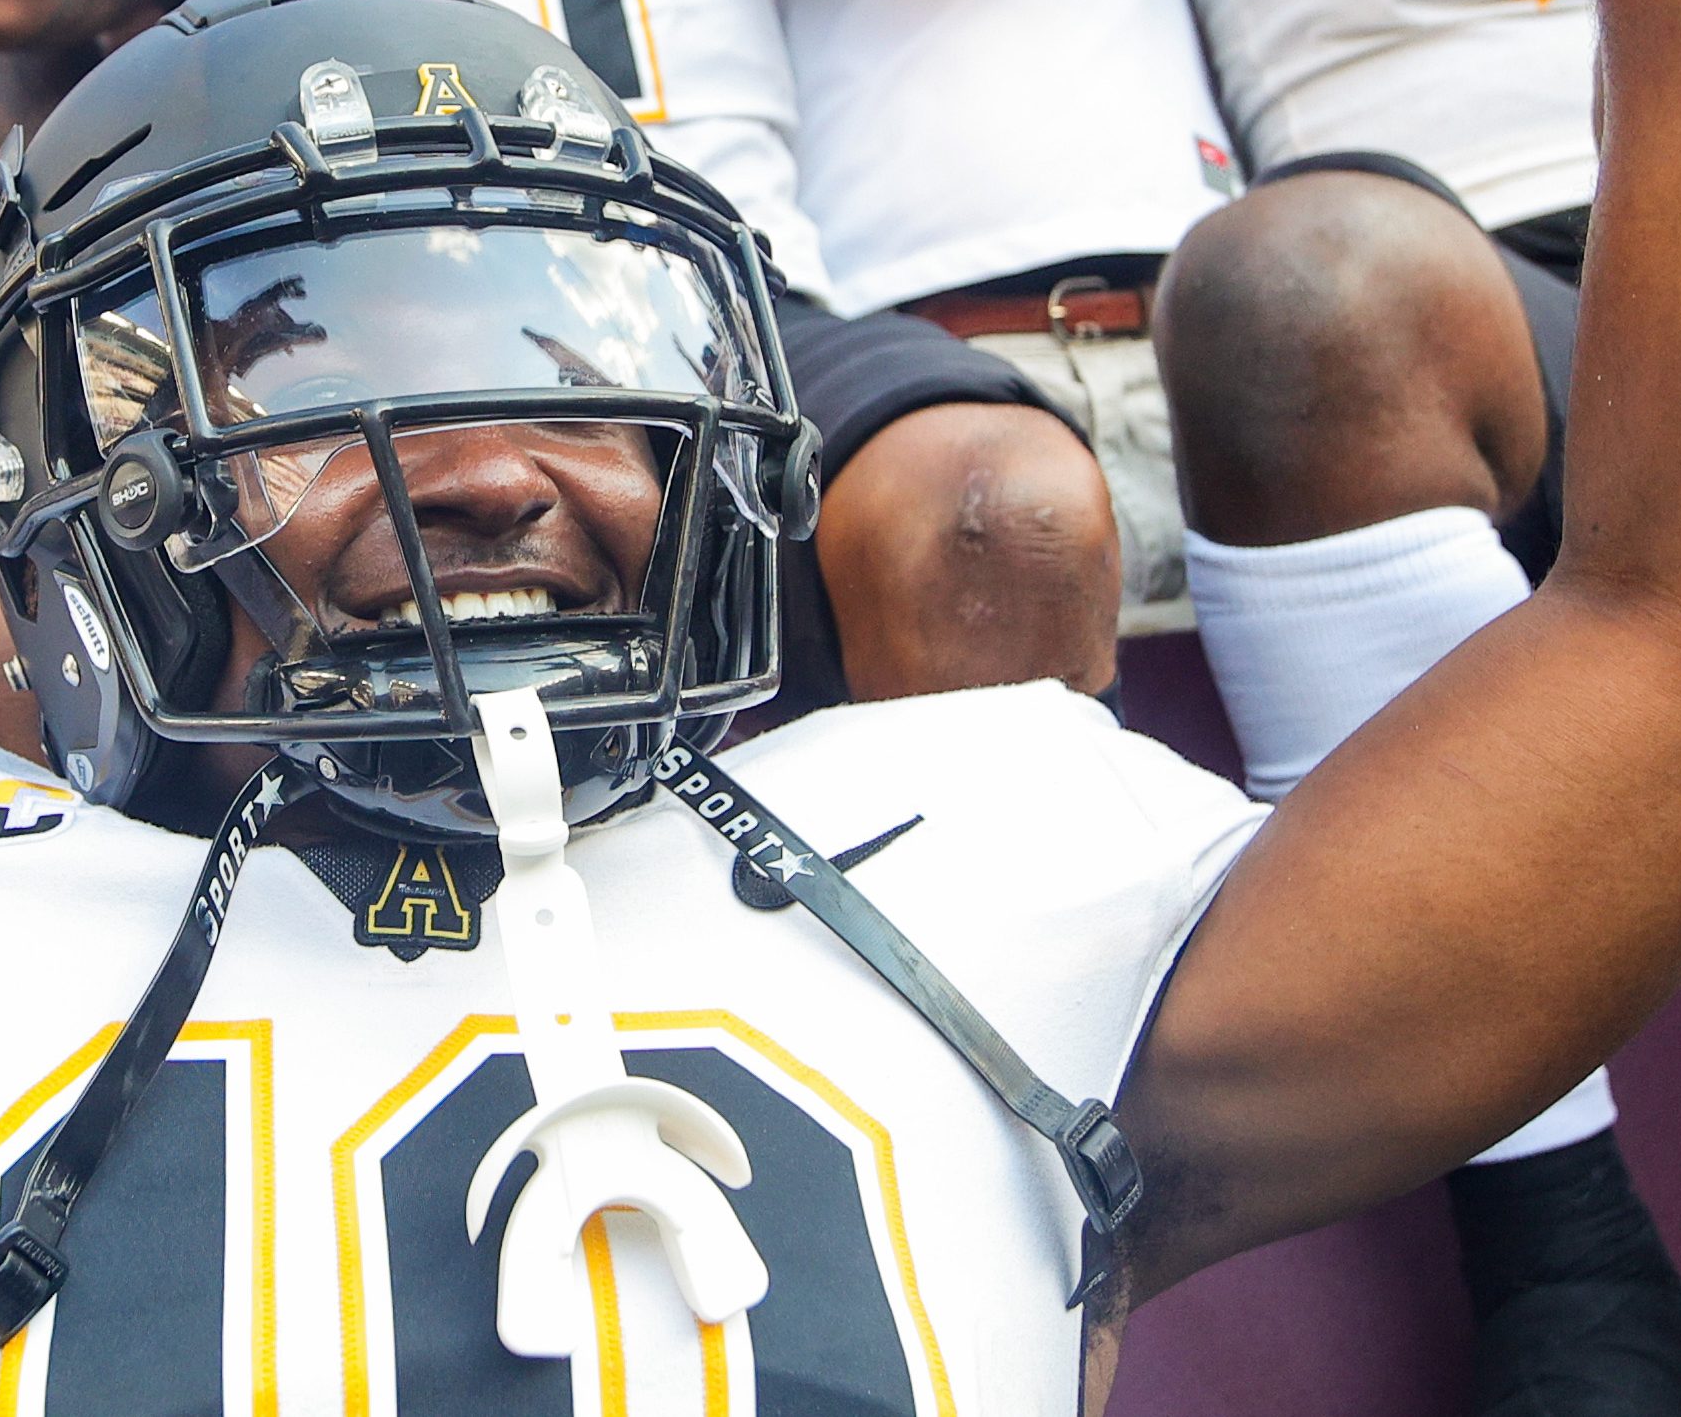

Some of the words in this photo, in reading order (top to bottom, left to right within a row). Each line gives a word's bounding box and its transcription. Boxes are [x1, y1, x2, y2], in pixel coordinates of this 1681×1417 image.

[414, 62, 481, 116] A
[68, 591, 106, 657] schutt
[652, 746, 785, 858] SPORT
[195, 800, 259, 949] SPORT
[367, 842, 472, 941] A
